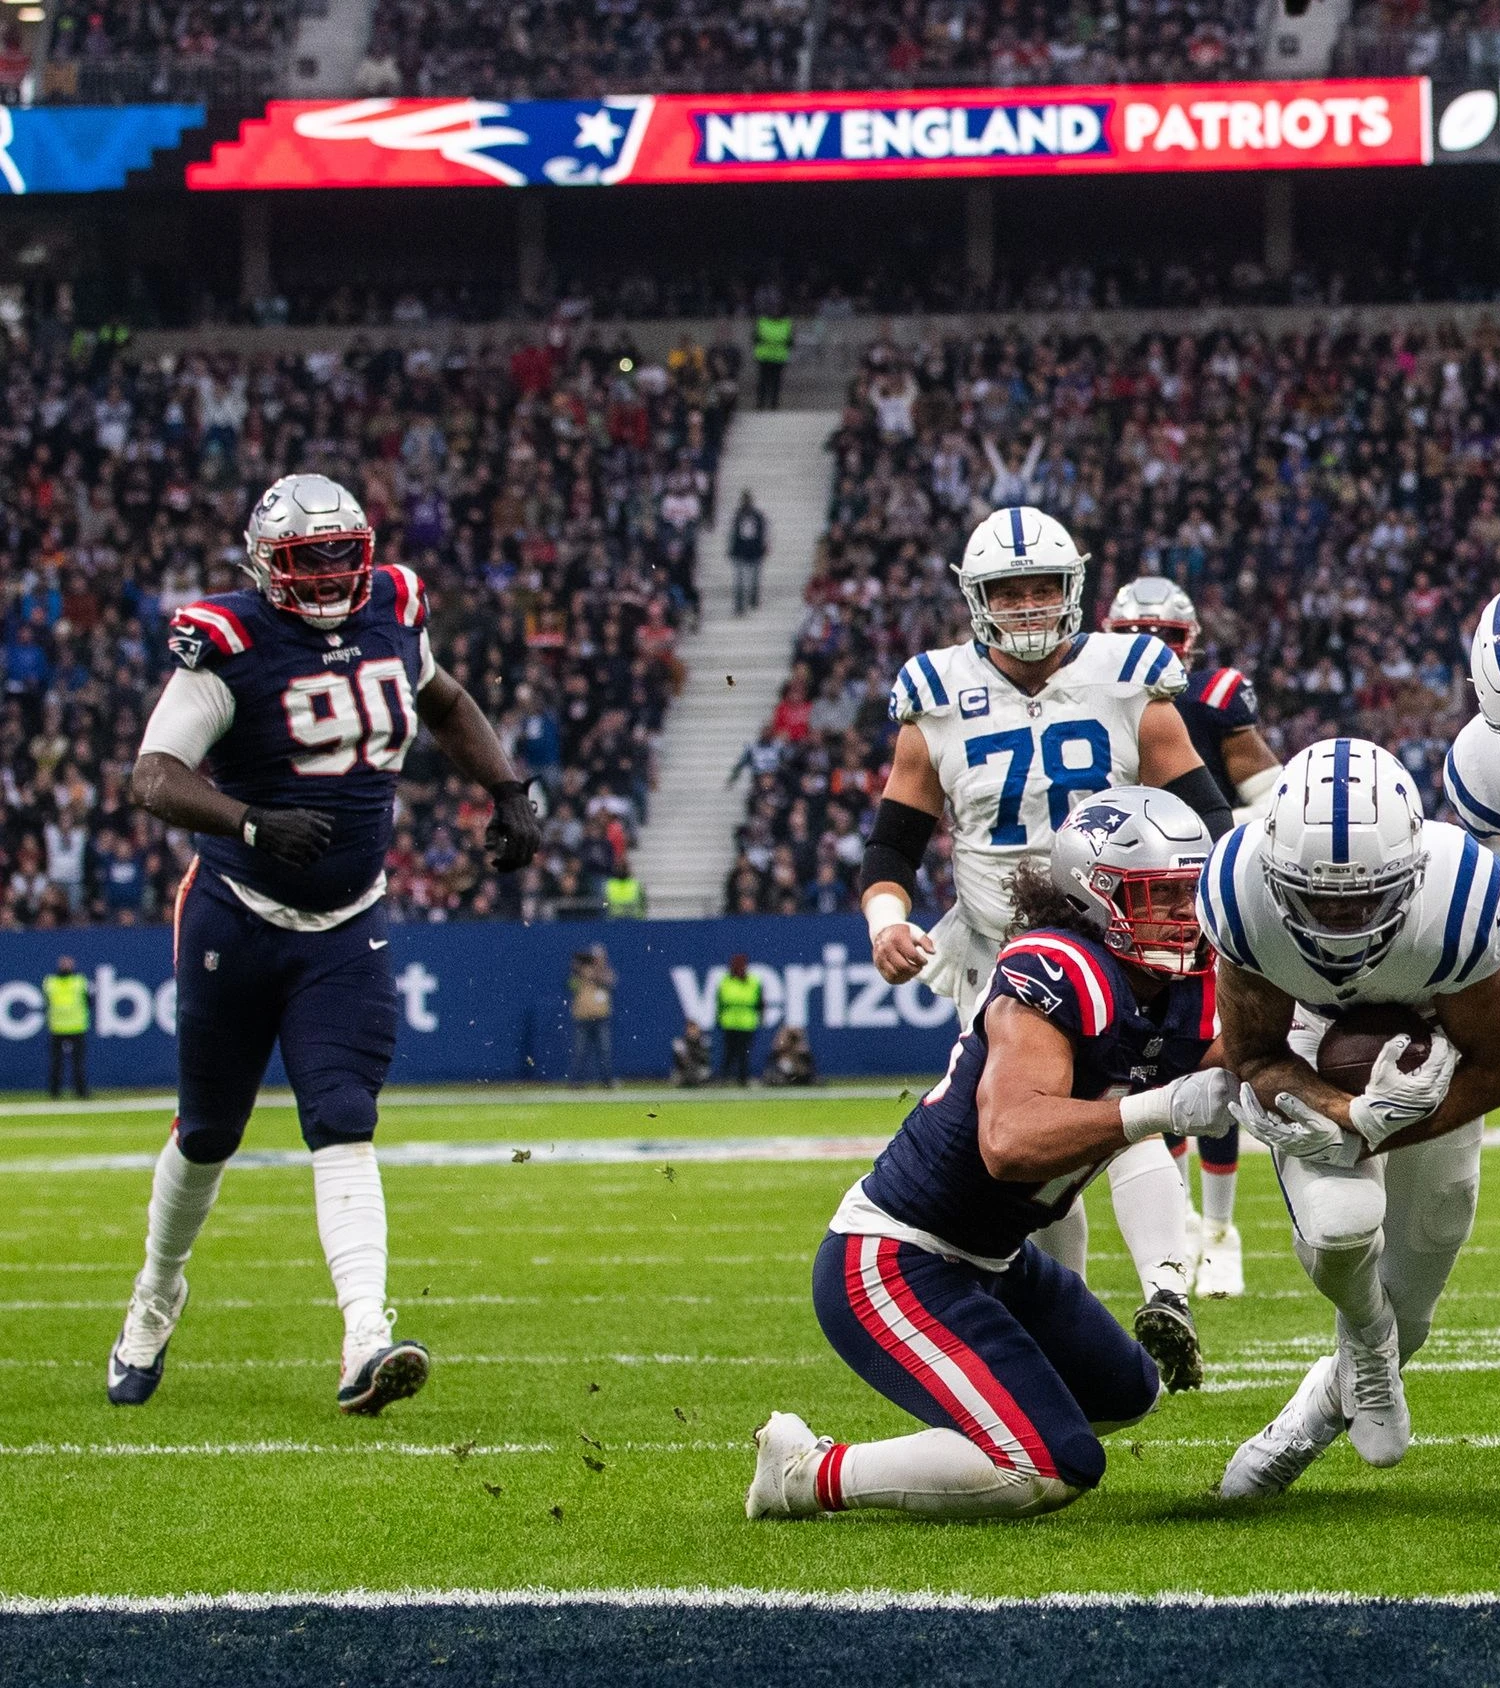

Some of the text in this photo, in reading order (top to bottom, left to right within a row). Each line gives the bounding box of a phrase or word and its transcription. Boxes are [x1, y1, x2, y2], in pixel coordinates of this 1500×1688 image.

[705, 96, 1393, 163] NEW ENGLAND PATRIOTS
[1010, 559, 1034, 568] COLTS
[282, 656, 418, 777] 90
[960, 688, 988, 712] C
[964, 718, 1113, 847] 78
